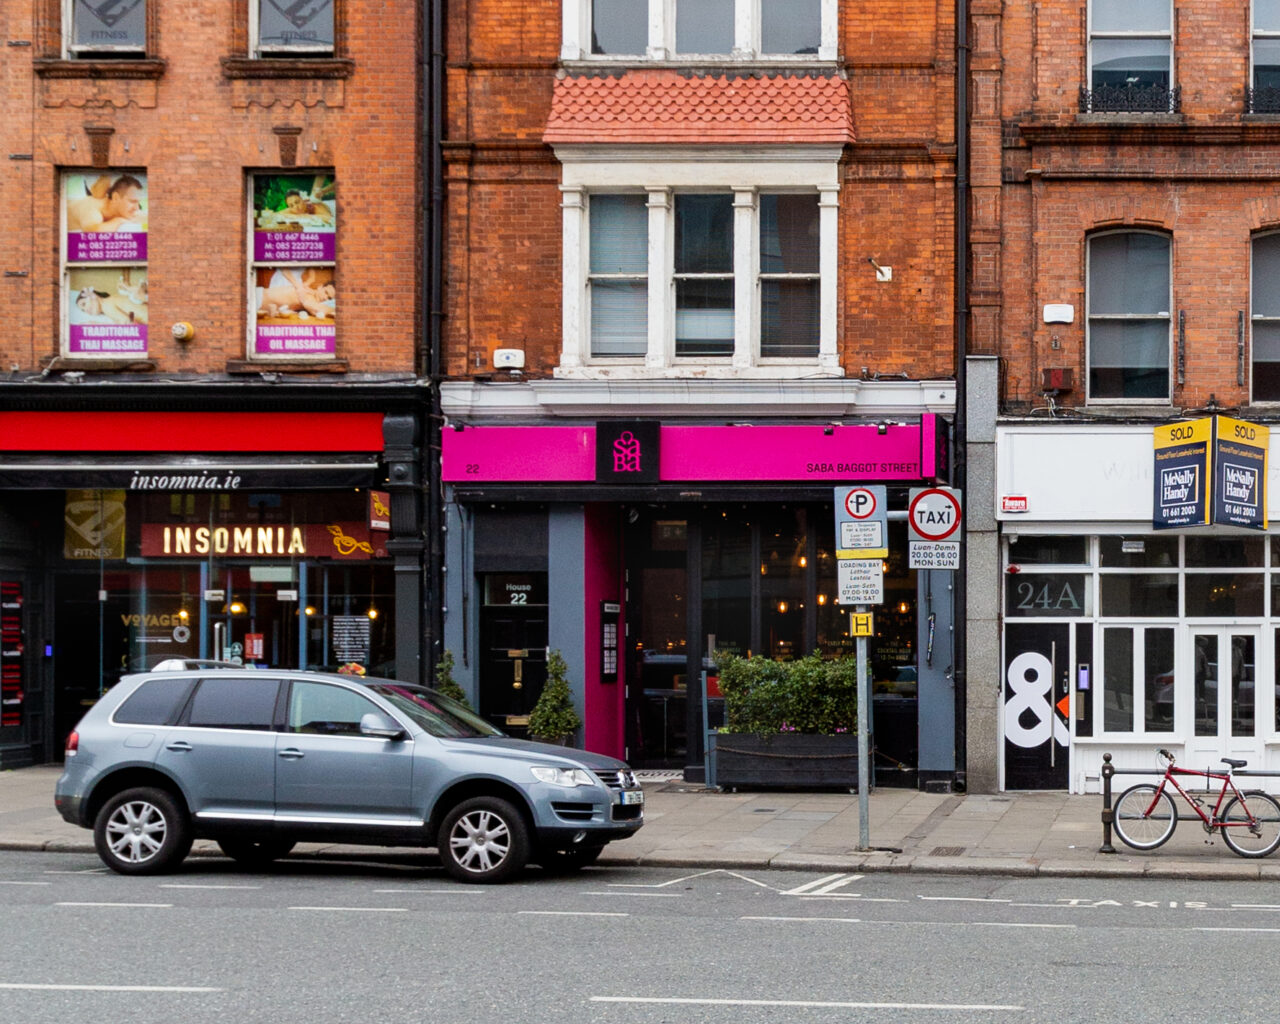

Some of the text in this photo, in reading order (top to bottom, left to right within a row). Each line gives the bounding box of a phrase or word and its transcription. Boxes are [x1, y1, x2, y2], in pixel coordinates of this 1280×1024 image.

[88, 232, 97, 241] 01
[274, 233, 283, 241] 01
[89, 241, 104, 250] 085
[275, 242, 290, 250] 085
[89, 251, 104, 259] 085
[275, 251, 290, 259] 085
[82, 326, 140, 337] TRADITIONAL
[258, 326, 314, 337] TRADITIONAL
[79, 339, 145, 350] THAI MASSAGE
[269, 339, 326, 350] OIL MASSAGE
[1170, 426, 1194, 441] SOLD
[1234, 425, 1256, 441] SOLD
[466, 464, 480, 474] 22
[806, 463, 918, 473] SABA BAGGOT STREET
[130, 470, 241, 490] insomnia.ie
[1163, 469, 1195, 487] McNally
[1226, 468, 1255, 489] McNally
[1163, 484, 1189, 501] Handy
[1226, 483, 1250, 502] Handy
[855, 494, 868, 513] P
[1162, 506, 1196, 517] 01 661 2003
[1225, 504, 1256, 517] 01 661 2003
[917, 510, 951, 525] TAXI
[163, 527, 307, 554] INSOMNIA
[73, 548, 113, 558] FITNESS
[506, 583, 532, 591] House
[510, 593, 527, 605] 22
[1017, 581, 1081, 609] 24A
[1056, 898, 1208, 909] TAXIS
